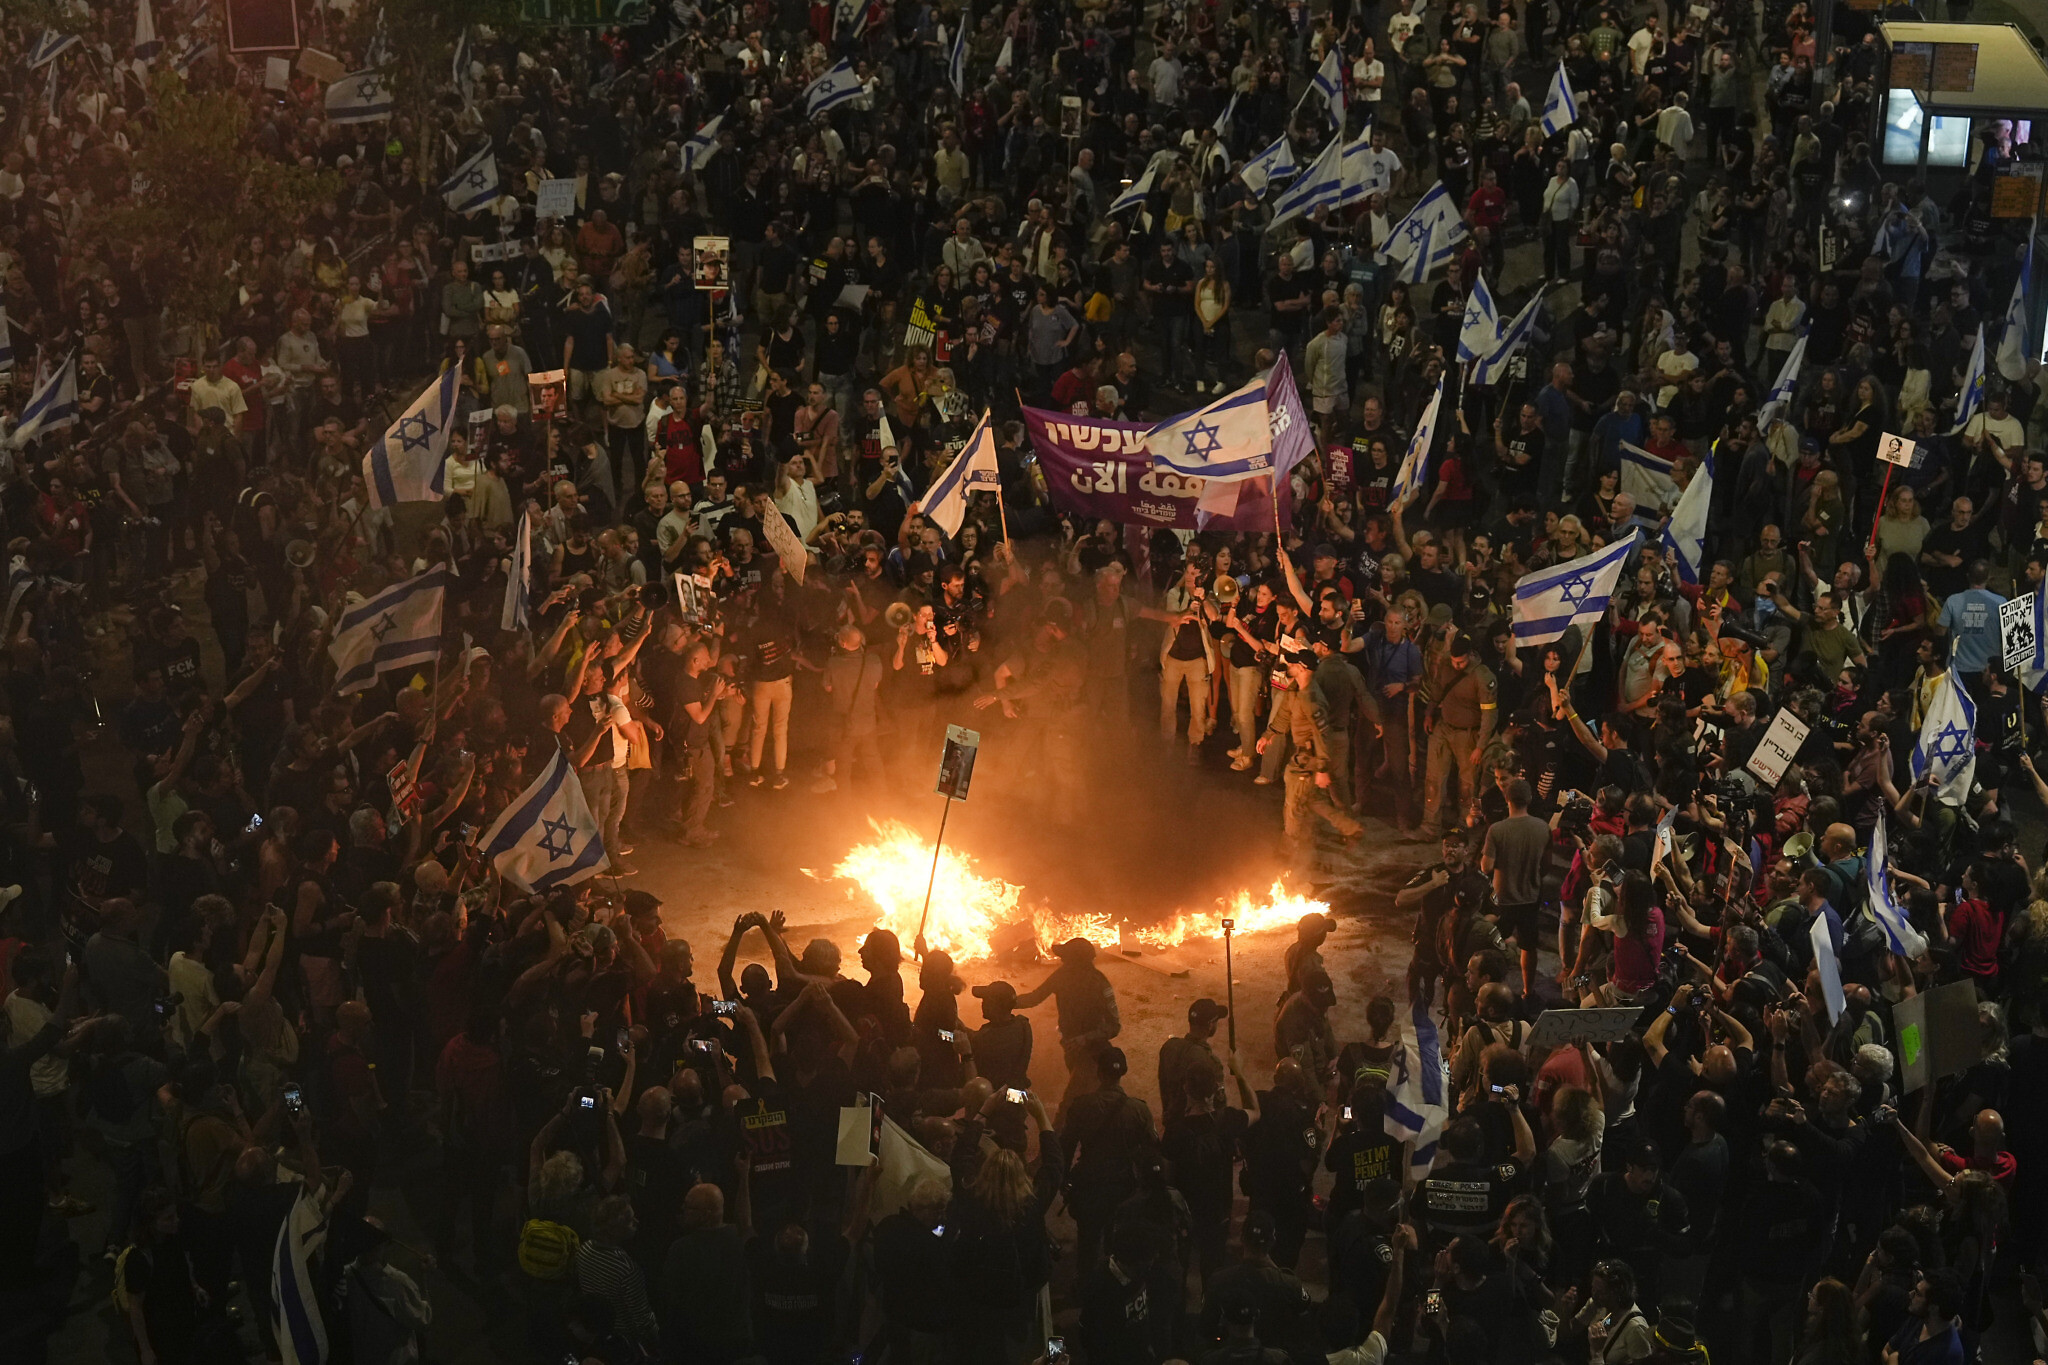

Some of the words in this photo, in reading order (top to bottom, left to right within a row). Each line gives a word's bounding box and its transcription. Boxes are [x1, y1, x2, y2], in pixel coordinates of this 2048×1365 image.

[910, 306, 937, 333] HOME
[1046, 422, 1147, 454] עכשיו
[2022, 595, 2032, 607] מי
[2020, 607, 2032, 621] לא
[168, 659, 195, 676] FCK
[1780, 717, 1794, 733] גביר
[1794, 731, 1804, 742] בן
[1763, 738, 1792, 762] עבריין
[1353, 1149, 1373, 1166] GET
[1374, 1145, 1390, 1161] MY
[1354, 1160, 1391, 1179] PEOPLE
